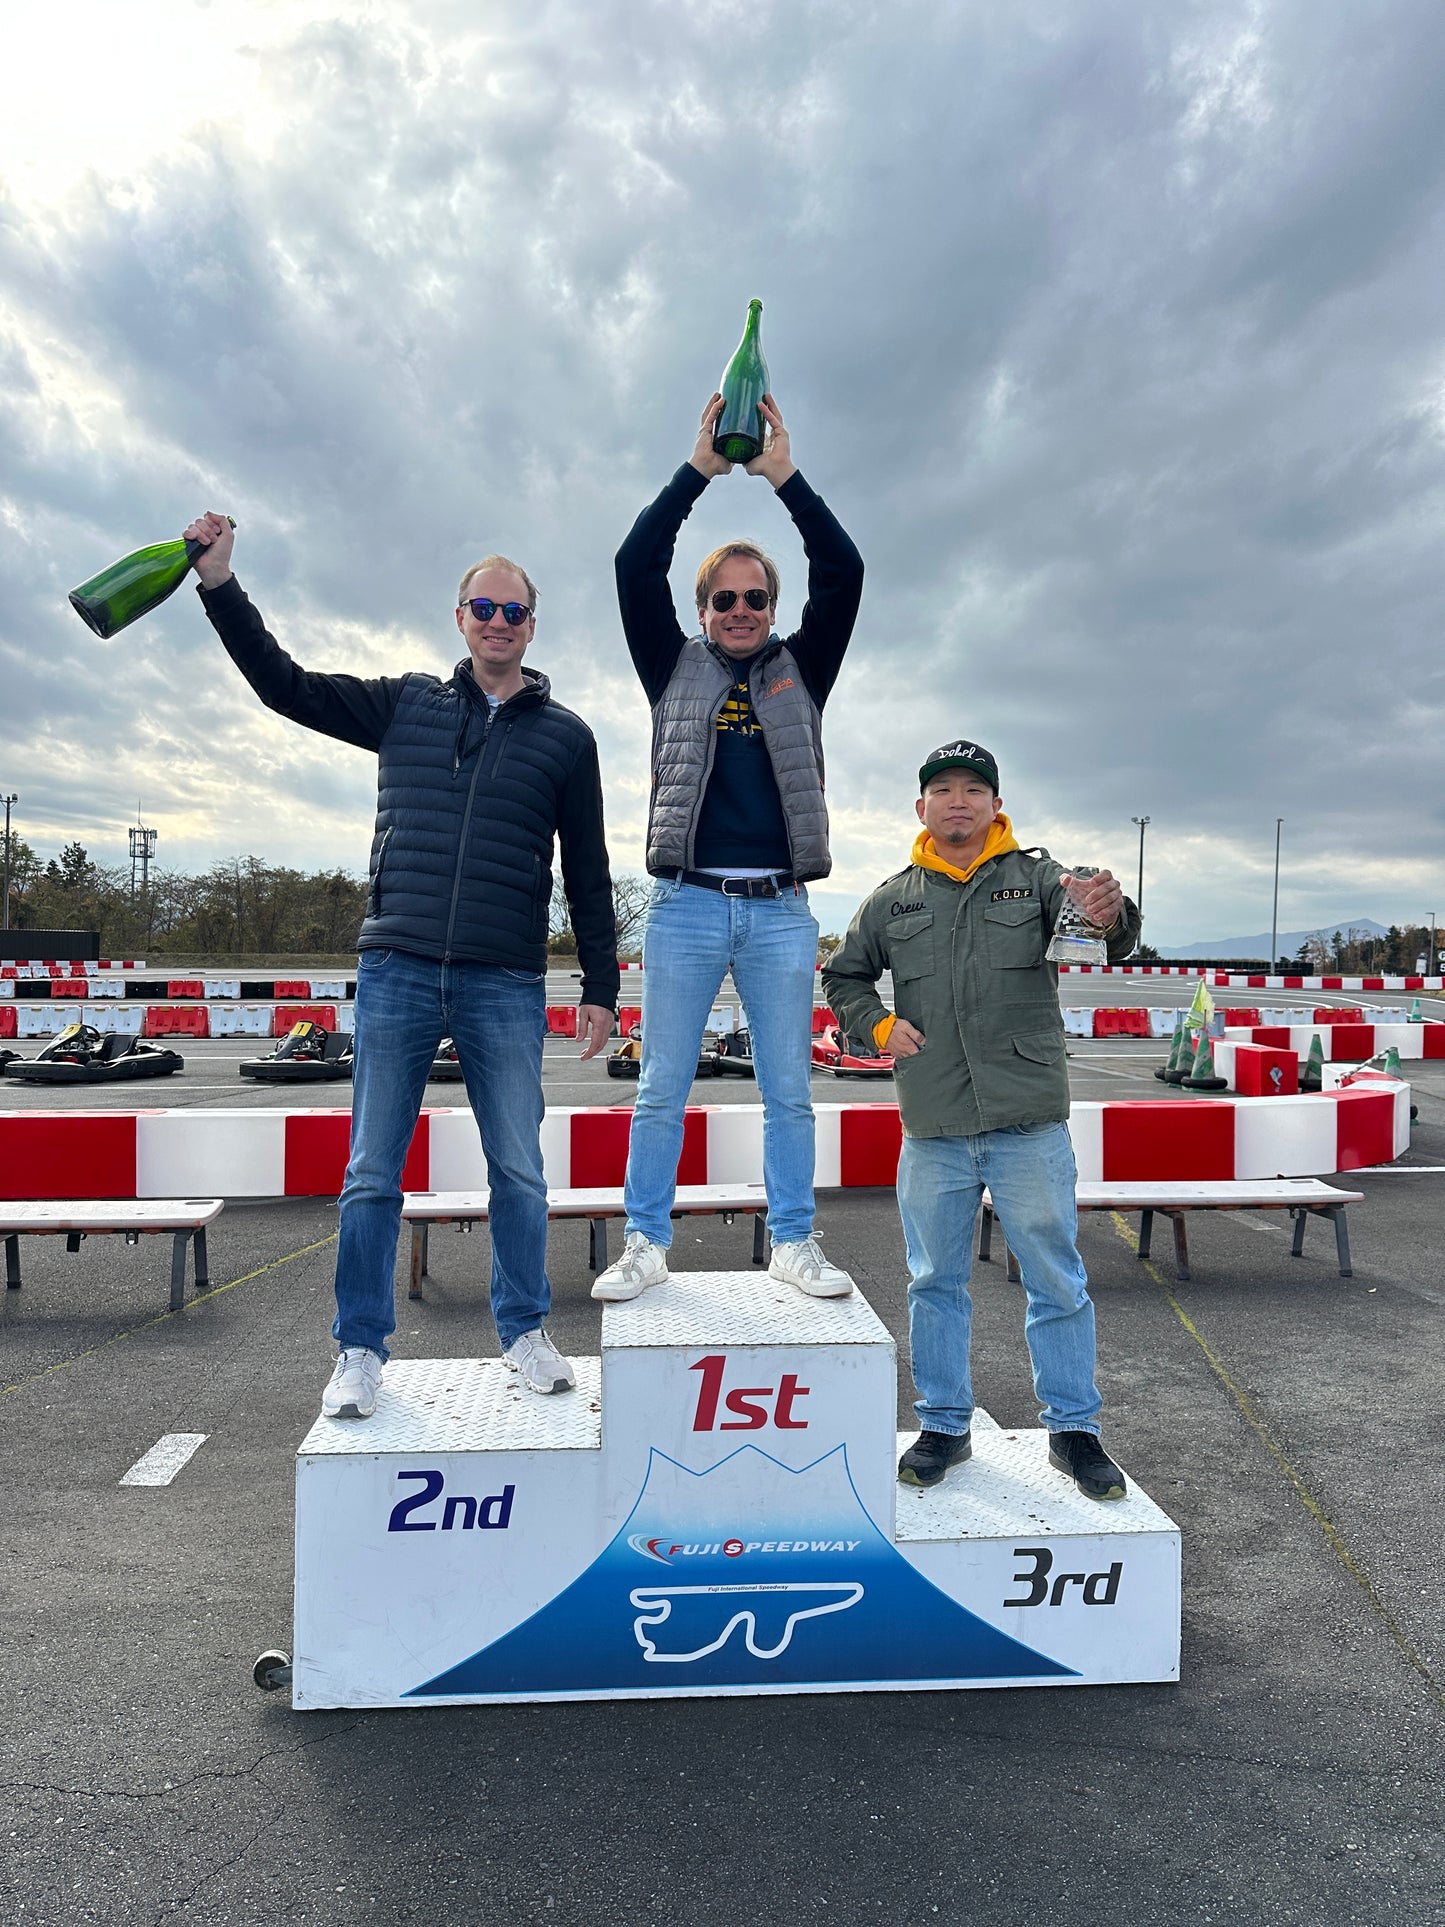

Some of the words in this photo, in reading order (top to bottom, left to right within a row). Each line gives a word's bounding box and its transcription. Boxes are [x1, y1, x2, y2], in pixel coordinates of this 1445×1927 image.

[891, 902, 926, 917] Crew
[297, 1023, 304, 1034] 1
[688, 1355, 811, 1432] 1st
[387, 1470, 516, 1532] 2nd
[668, 1544, 719, 1556] FUJI
[724, 1540, 862, 1556] SPEEDWAY
[1003, 1548, 1123, 1607] 3rd
